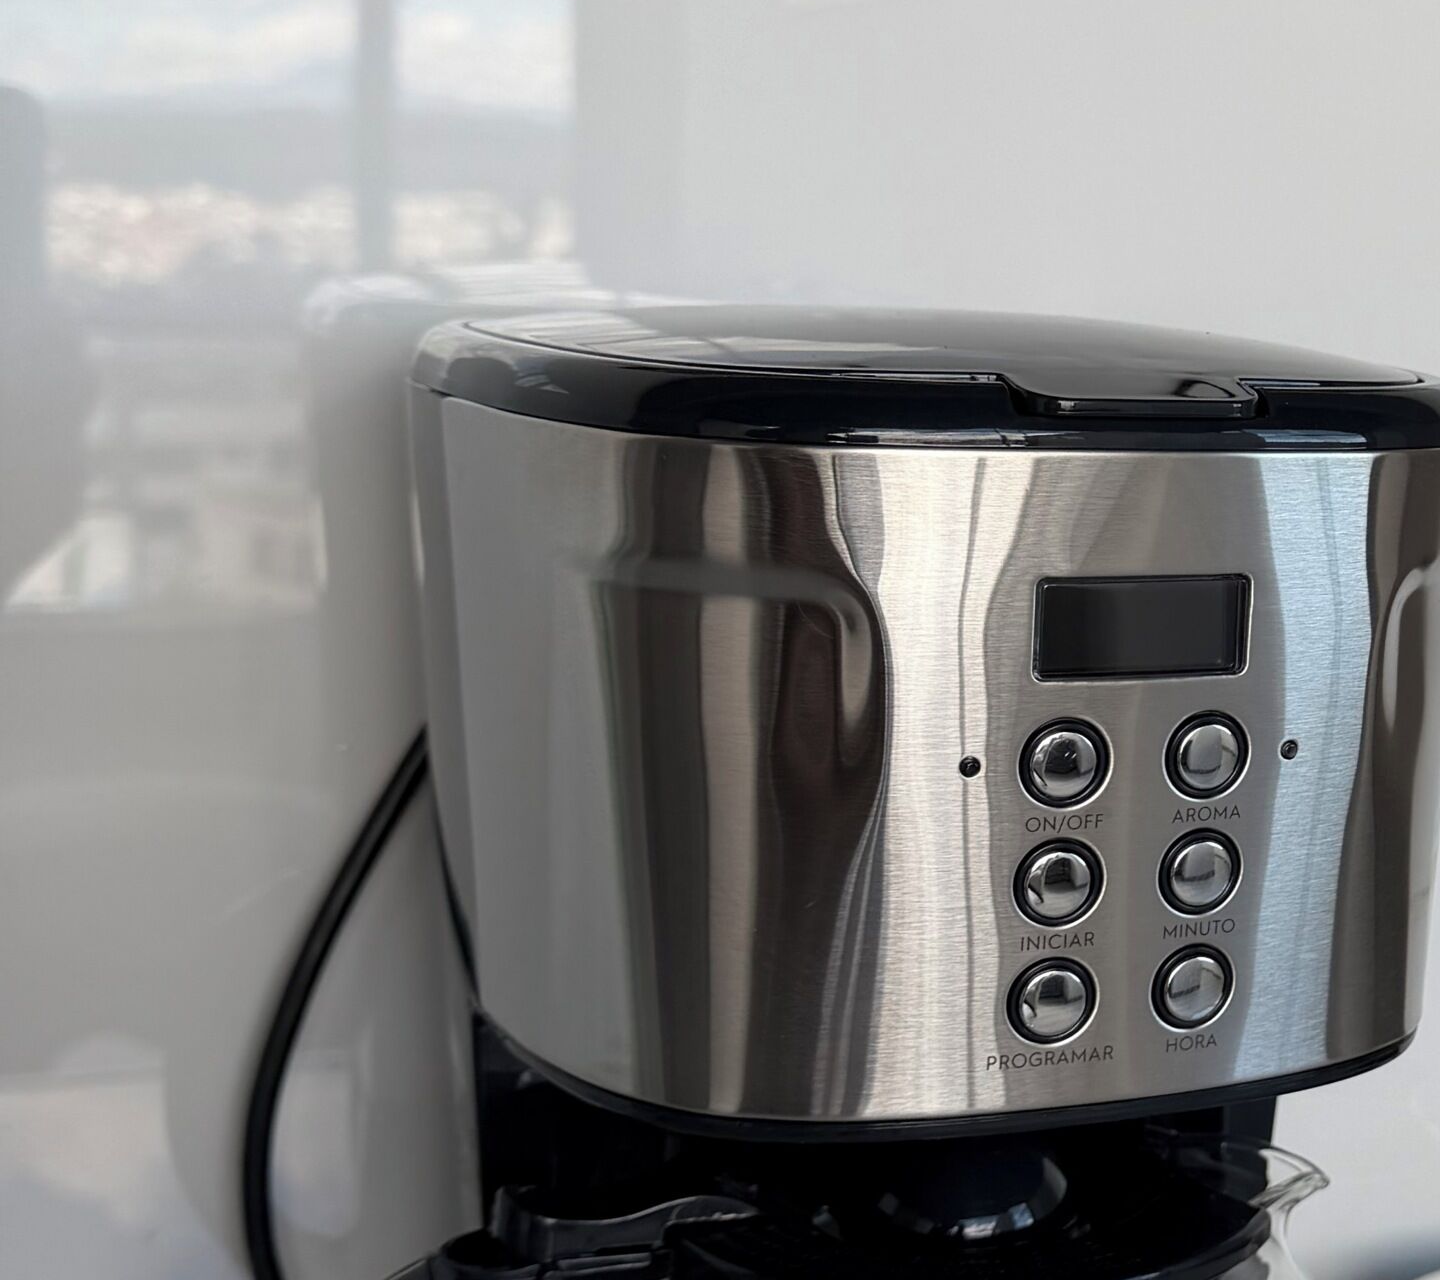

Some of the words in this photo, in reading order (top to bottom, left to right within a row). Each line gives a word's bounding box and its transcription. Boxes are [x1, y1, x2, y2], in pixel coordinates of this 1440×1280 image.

[1025, 813, 1105, 834] ON/OFF
[1172, 804, 1241, 824] AROMA
[1162, 918, 1236, 940] MINUTO
[1020, 931, 1095, 952] INICIAR
[1166, 1033, 1217, 1053] HORA
[986, 1045, 1114, 1071] PROGRAMAR
